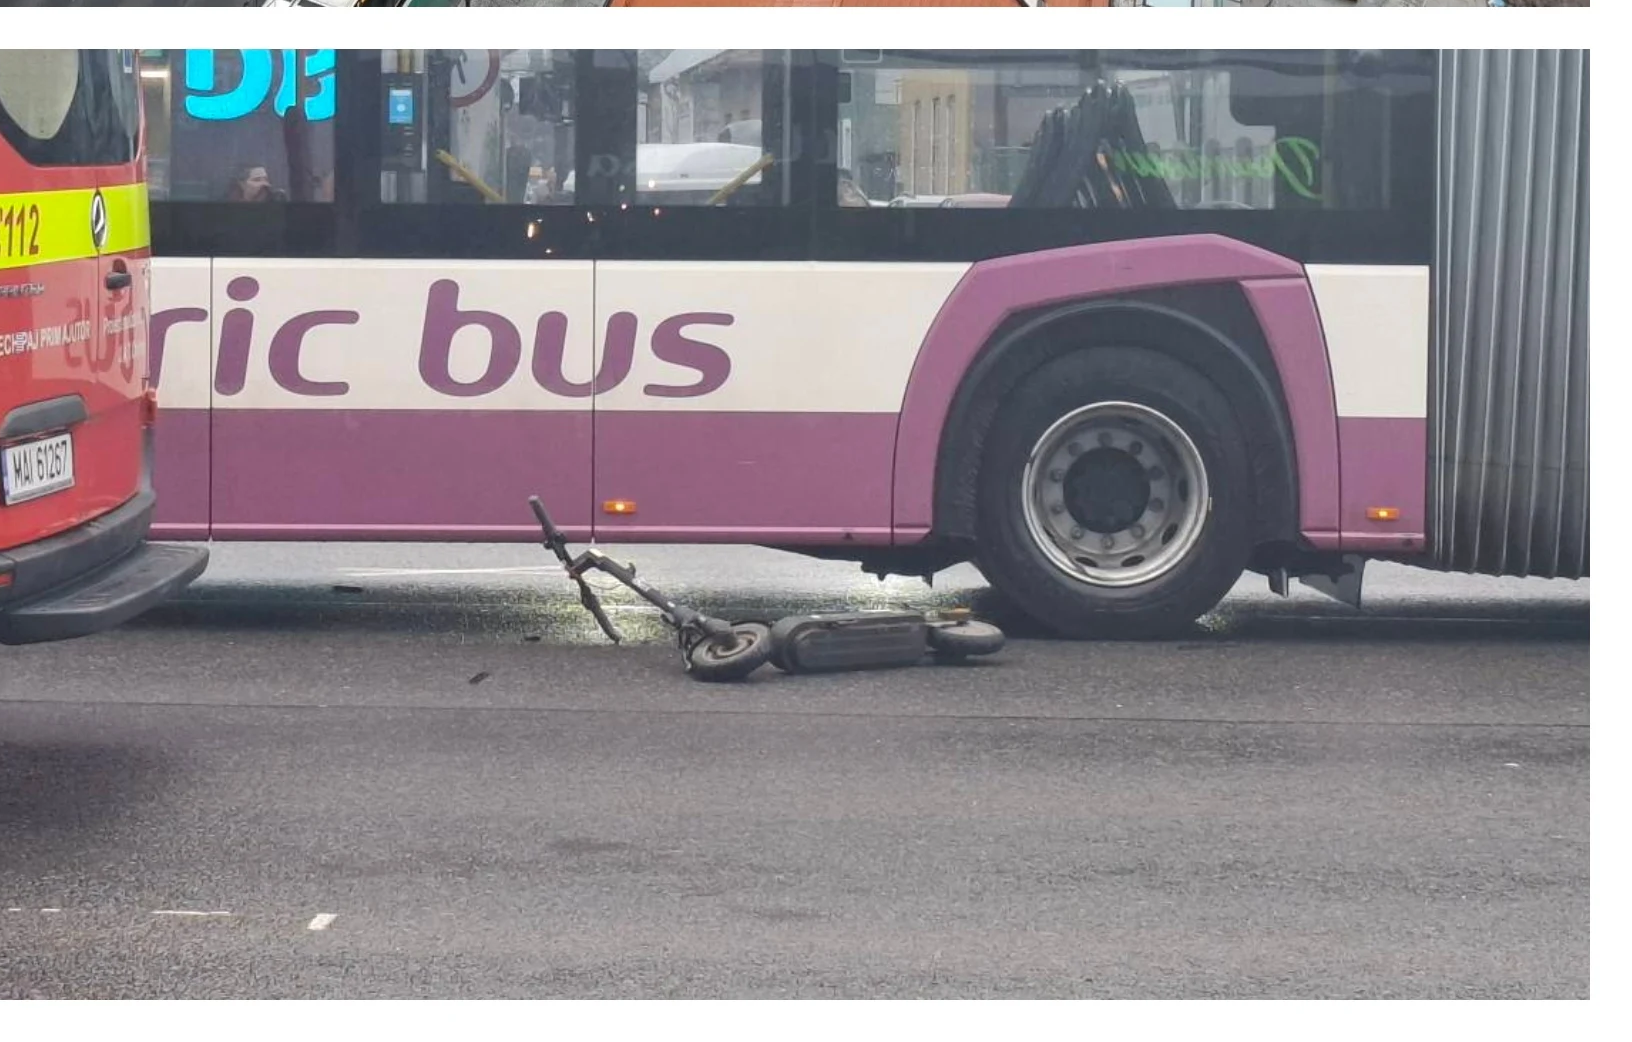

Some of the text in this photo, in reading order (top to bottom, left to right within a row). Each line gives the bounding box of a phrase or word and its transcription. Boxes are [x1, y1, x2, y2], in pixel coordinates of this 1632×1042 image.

[4, 203, 41, 257] 112
[149, 275, 360, 396] ric
[418, 278, 735, 398] bus
[12, 439, 67, 488] MAI 61267
